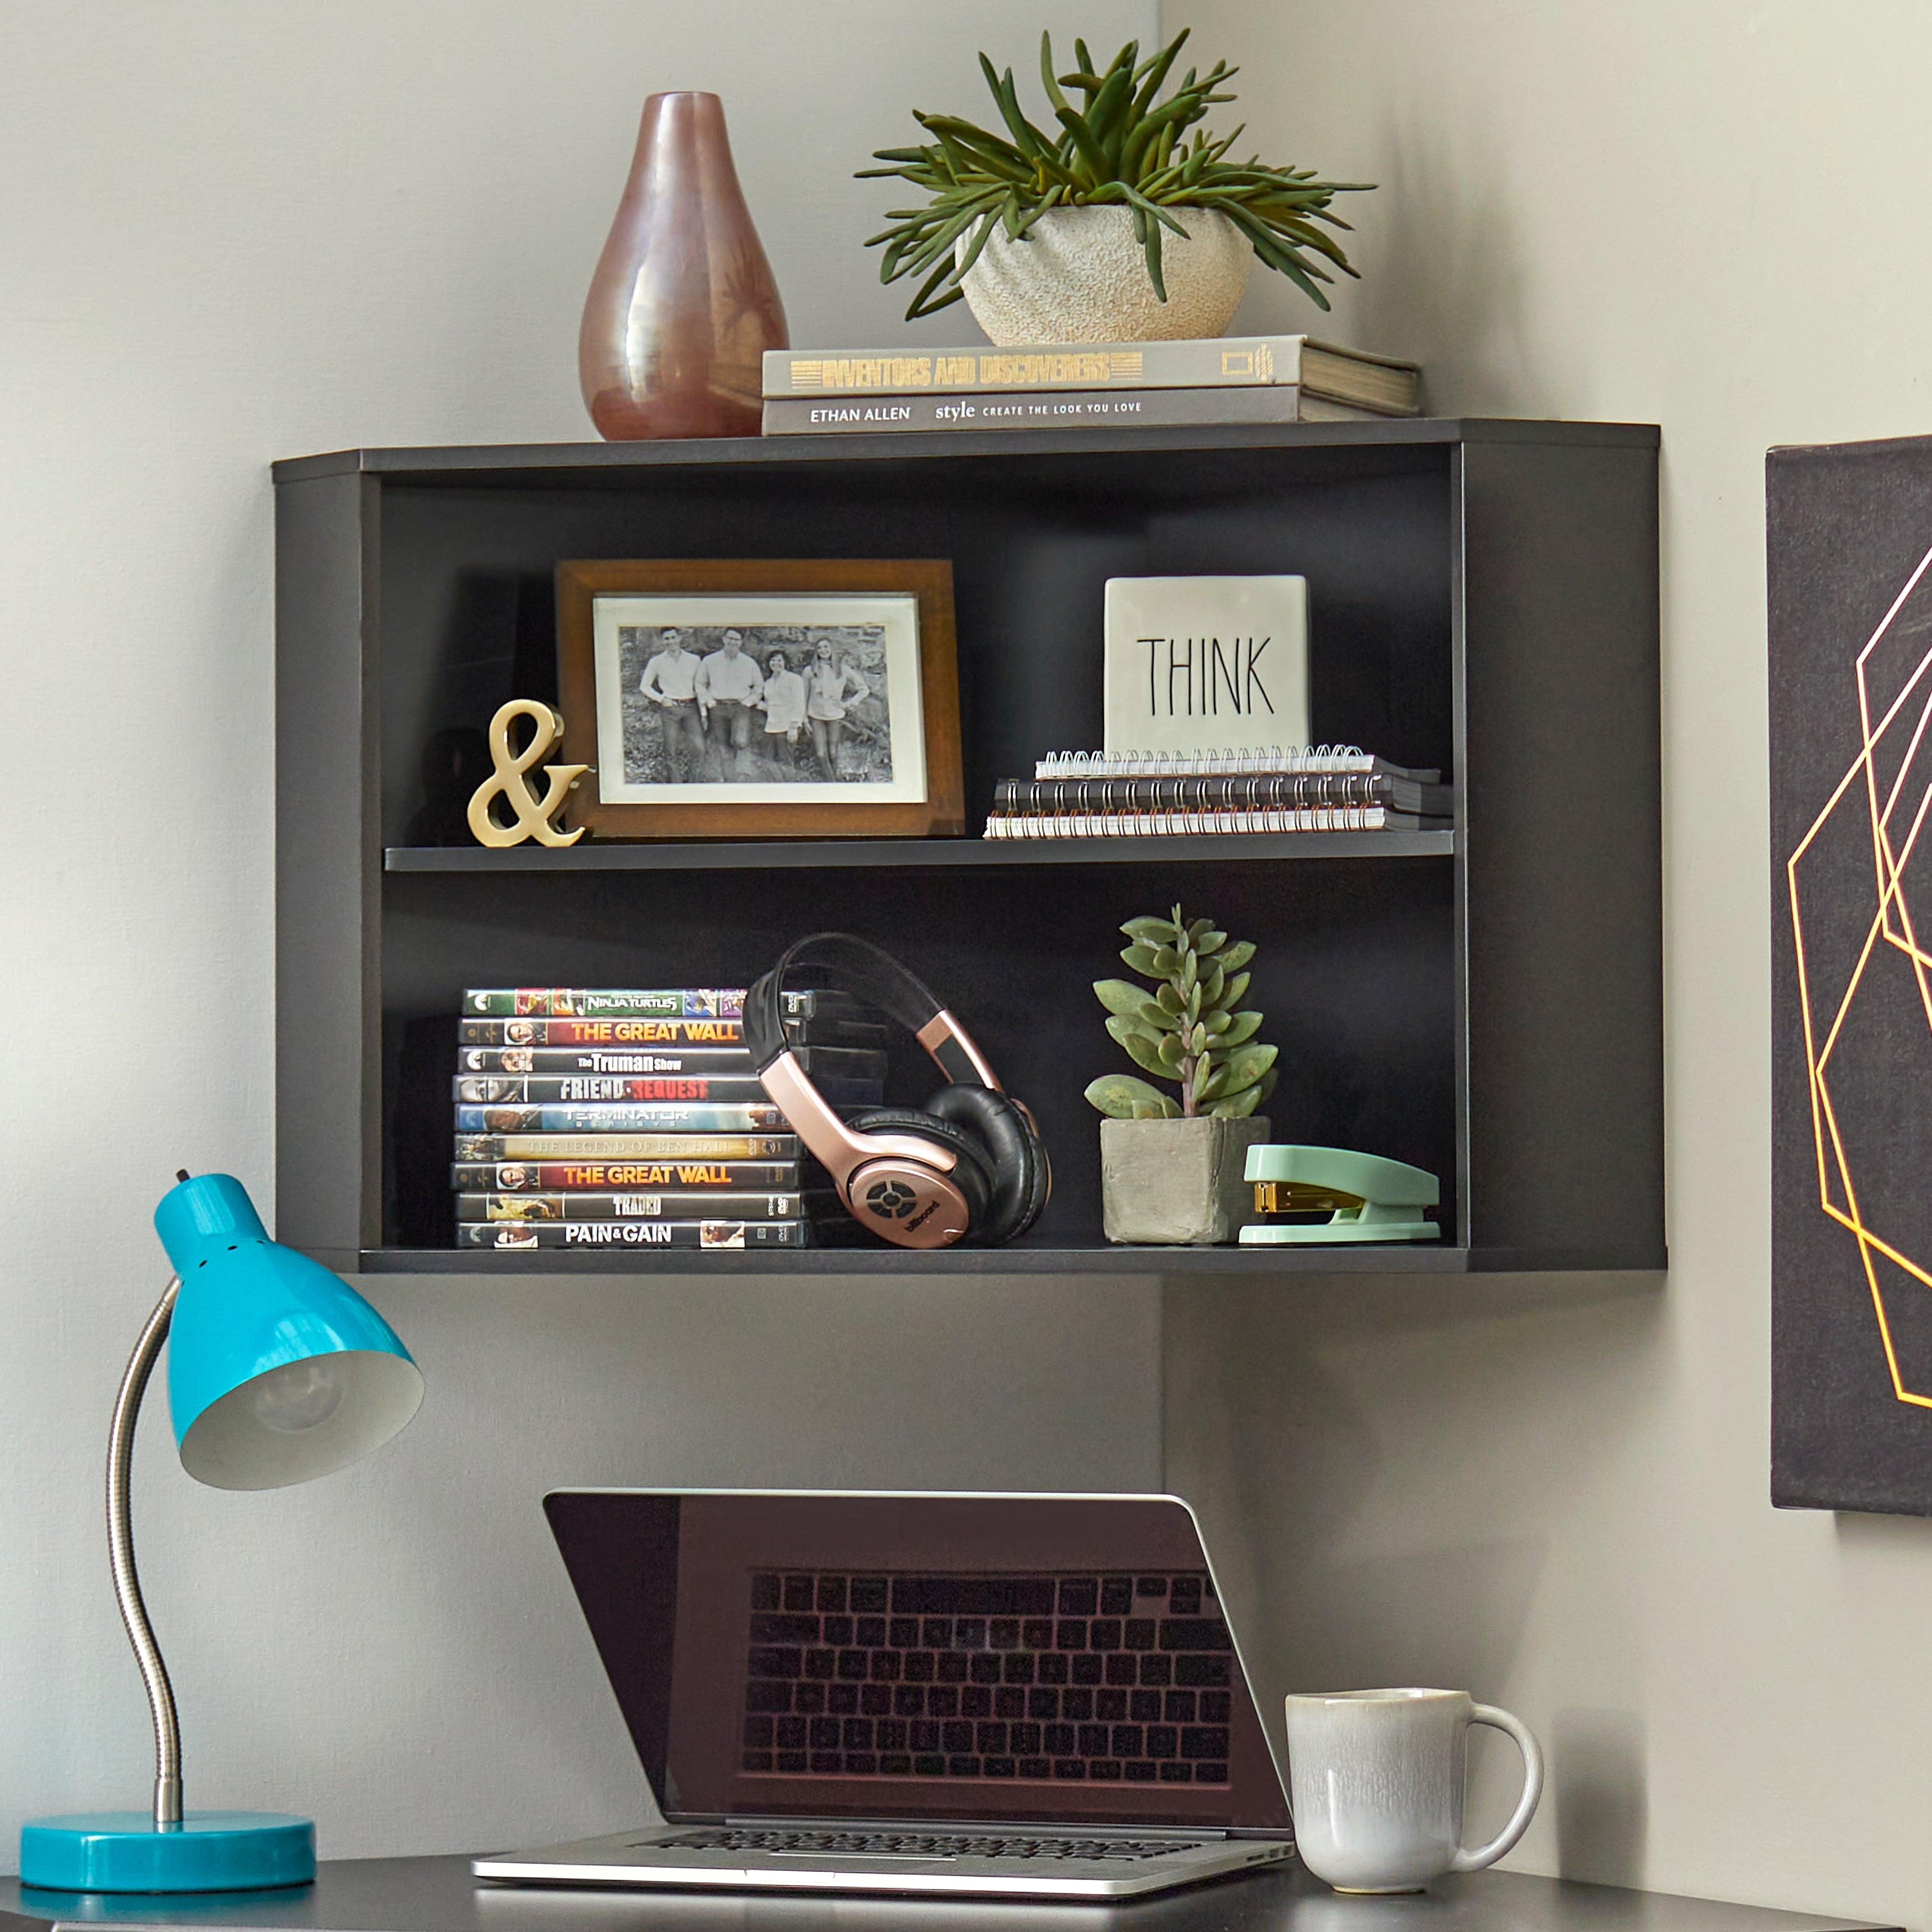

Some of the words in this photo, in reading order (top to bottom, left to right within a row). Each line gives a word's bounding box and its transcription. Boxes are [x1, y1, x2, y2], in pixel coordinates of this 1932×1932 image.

[822, 357, 930, 387] INVENTORS
[935, 356, 975, 385] AND
[980, 353, 1110, 385] DISCOVERERS
[810, 409, 860, 423] ETHAN
[864, 407, 911, 421] ALLEN
[936, 401, 975, 422] style
[983, 406, 1023, 416] CREATE
[1028, 405, 1048, 415] THE
[1054, 404, 1081, 414] LOOK
[1087, 404, 1108, 413] YOU
[1114, 402, 1141, 412] LOVE
[1137, 637, 1274, 716] THINK
[587, 996, 628, 1010] NINJA
[628, 997, 677, 1011] TURTLES
[571, 1023, 611, 1040] THE
[615, 1023, 681, 1041] GREAT
[683, 1023, 739, 1040] WALL
[591, 1053, 654, 1071] Truman
[560, 1079, 623, 1099] FRIEND
[631, 1080, 708, 1100] REQUEST
[562, 1108, 689, 1120] TERMINATOR
[529, 1140, 560, 1153] THE
[564, 1140, 625, 1154] LEGEND
[631, 1140, 650, 1153] OF
[657, 1140, 686, 1153] BEN
[693, 1139, 731, 1153] HALL
[564, 1167, 604, 1184] THE
[608, 1166, 673, 1184] GREAT
[677, 1165, 732, 1183] WALL
[613, 1196, 661, 1215] TRADED
